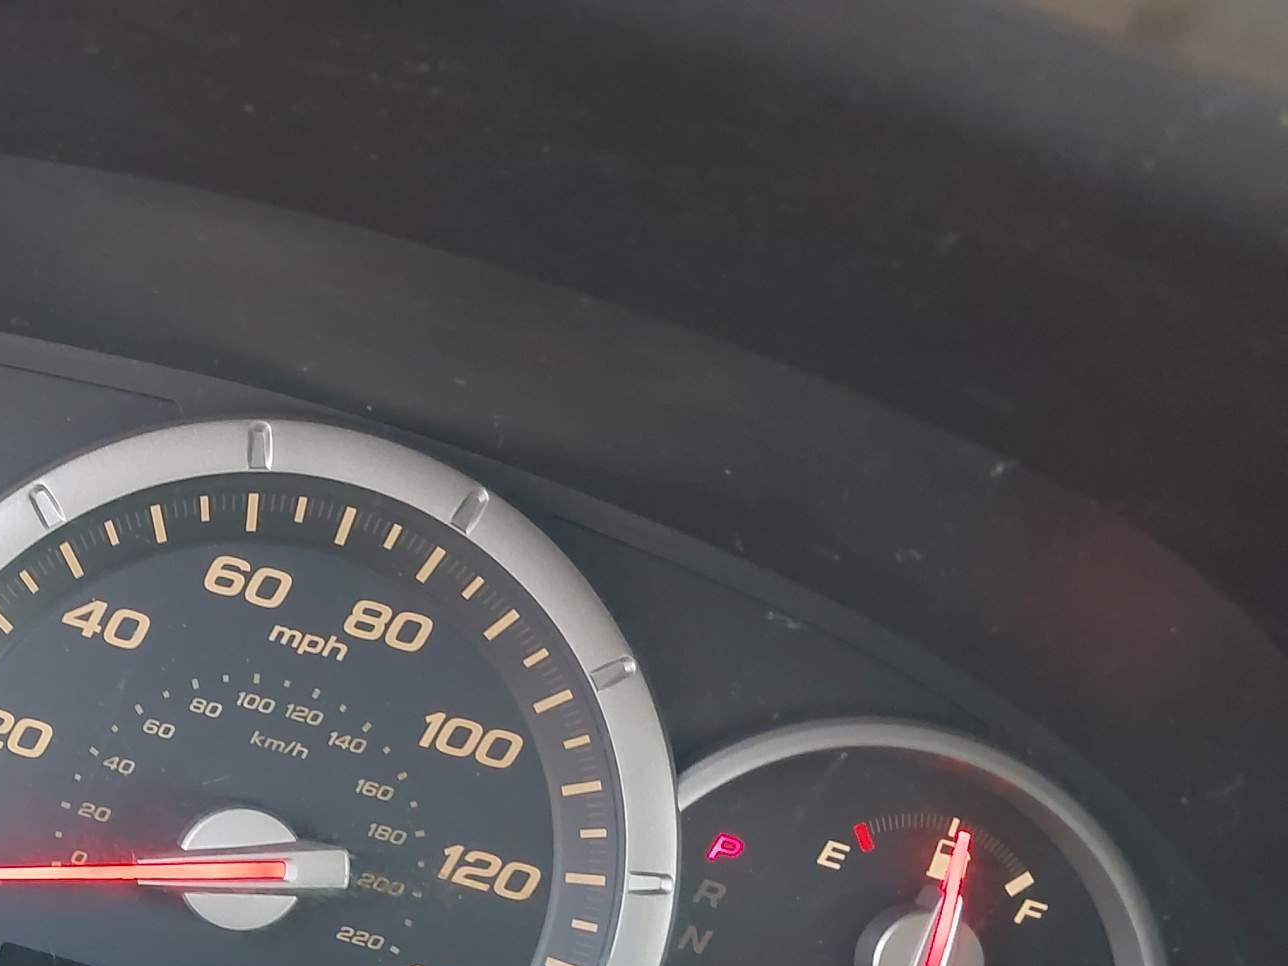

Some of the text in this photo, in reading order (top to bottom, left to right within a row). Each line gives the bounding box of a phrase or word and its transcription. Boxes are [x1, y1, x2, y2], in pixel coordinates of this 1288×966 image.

[203, 555, 293, 609] 60
[61, 599, 150, 649] 40
[343, 599, 433, 652] 80
[268, 622, 349, 662] mph
[189, 697, 223, 718] 80
[236, 691, 276, 714] 100
[284, 703, 324, 726] 120
[142, 718, 176, 740] 60
[418, 711, 524, 770] 100
[250, 731, 309, 760] km/h
[327, 731, 367, 754] 140
[103, 755, 136, 776] 40
[355, 779, 395, 801] 160
[77, 803, 112, 823] 20
[367, 823, 408, 846] 180
[707, 832, 745, 861] P
[71, 850, 88, 866] 0
[817, 840, 851, 872] E
[356, 873, 405, 896] 200
[438, 844, 542, 901] 120
[692, 879, 727, 909] R
[1013, 898, 1049, 924] F
[336, 927, 385, 951] 220
[677, 925, 713, 955] N
